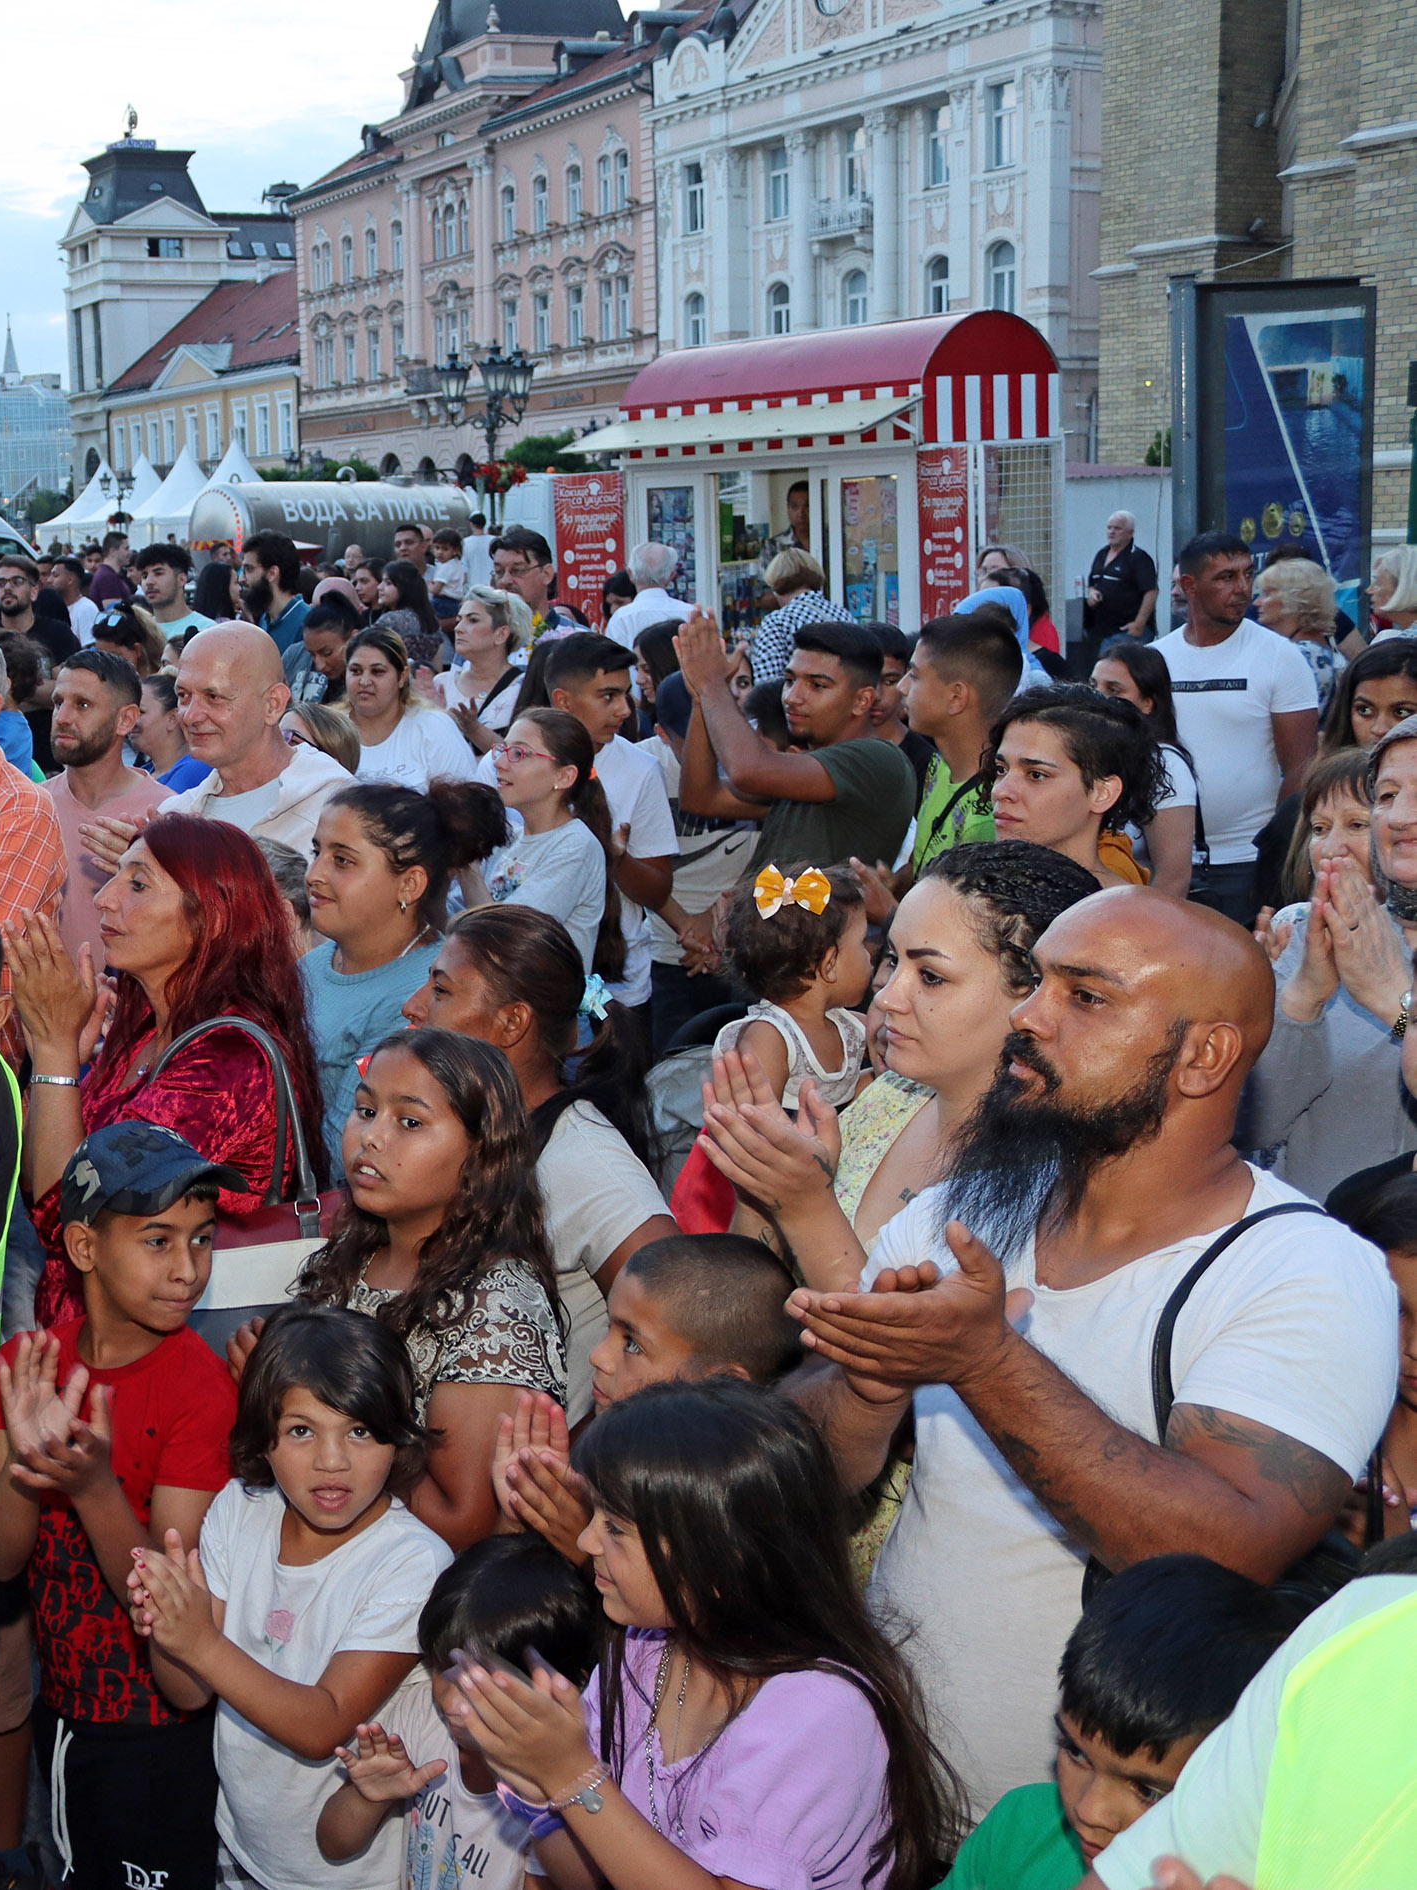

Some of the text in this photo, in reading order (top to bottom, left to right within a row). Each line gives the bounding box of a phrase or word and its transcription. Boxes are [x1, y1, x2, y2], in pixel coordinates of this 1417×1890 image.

[281, 499, 451, 527] ВОДА ЗА ПИЋЕ
